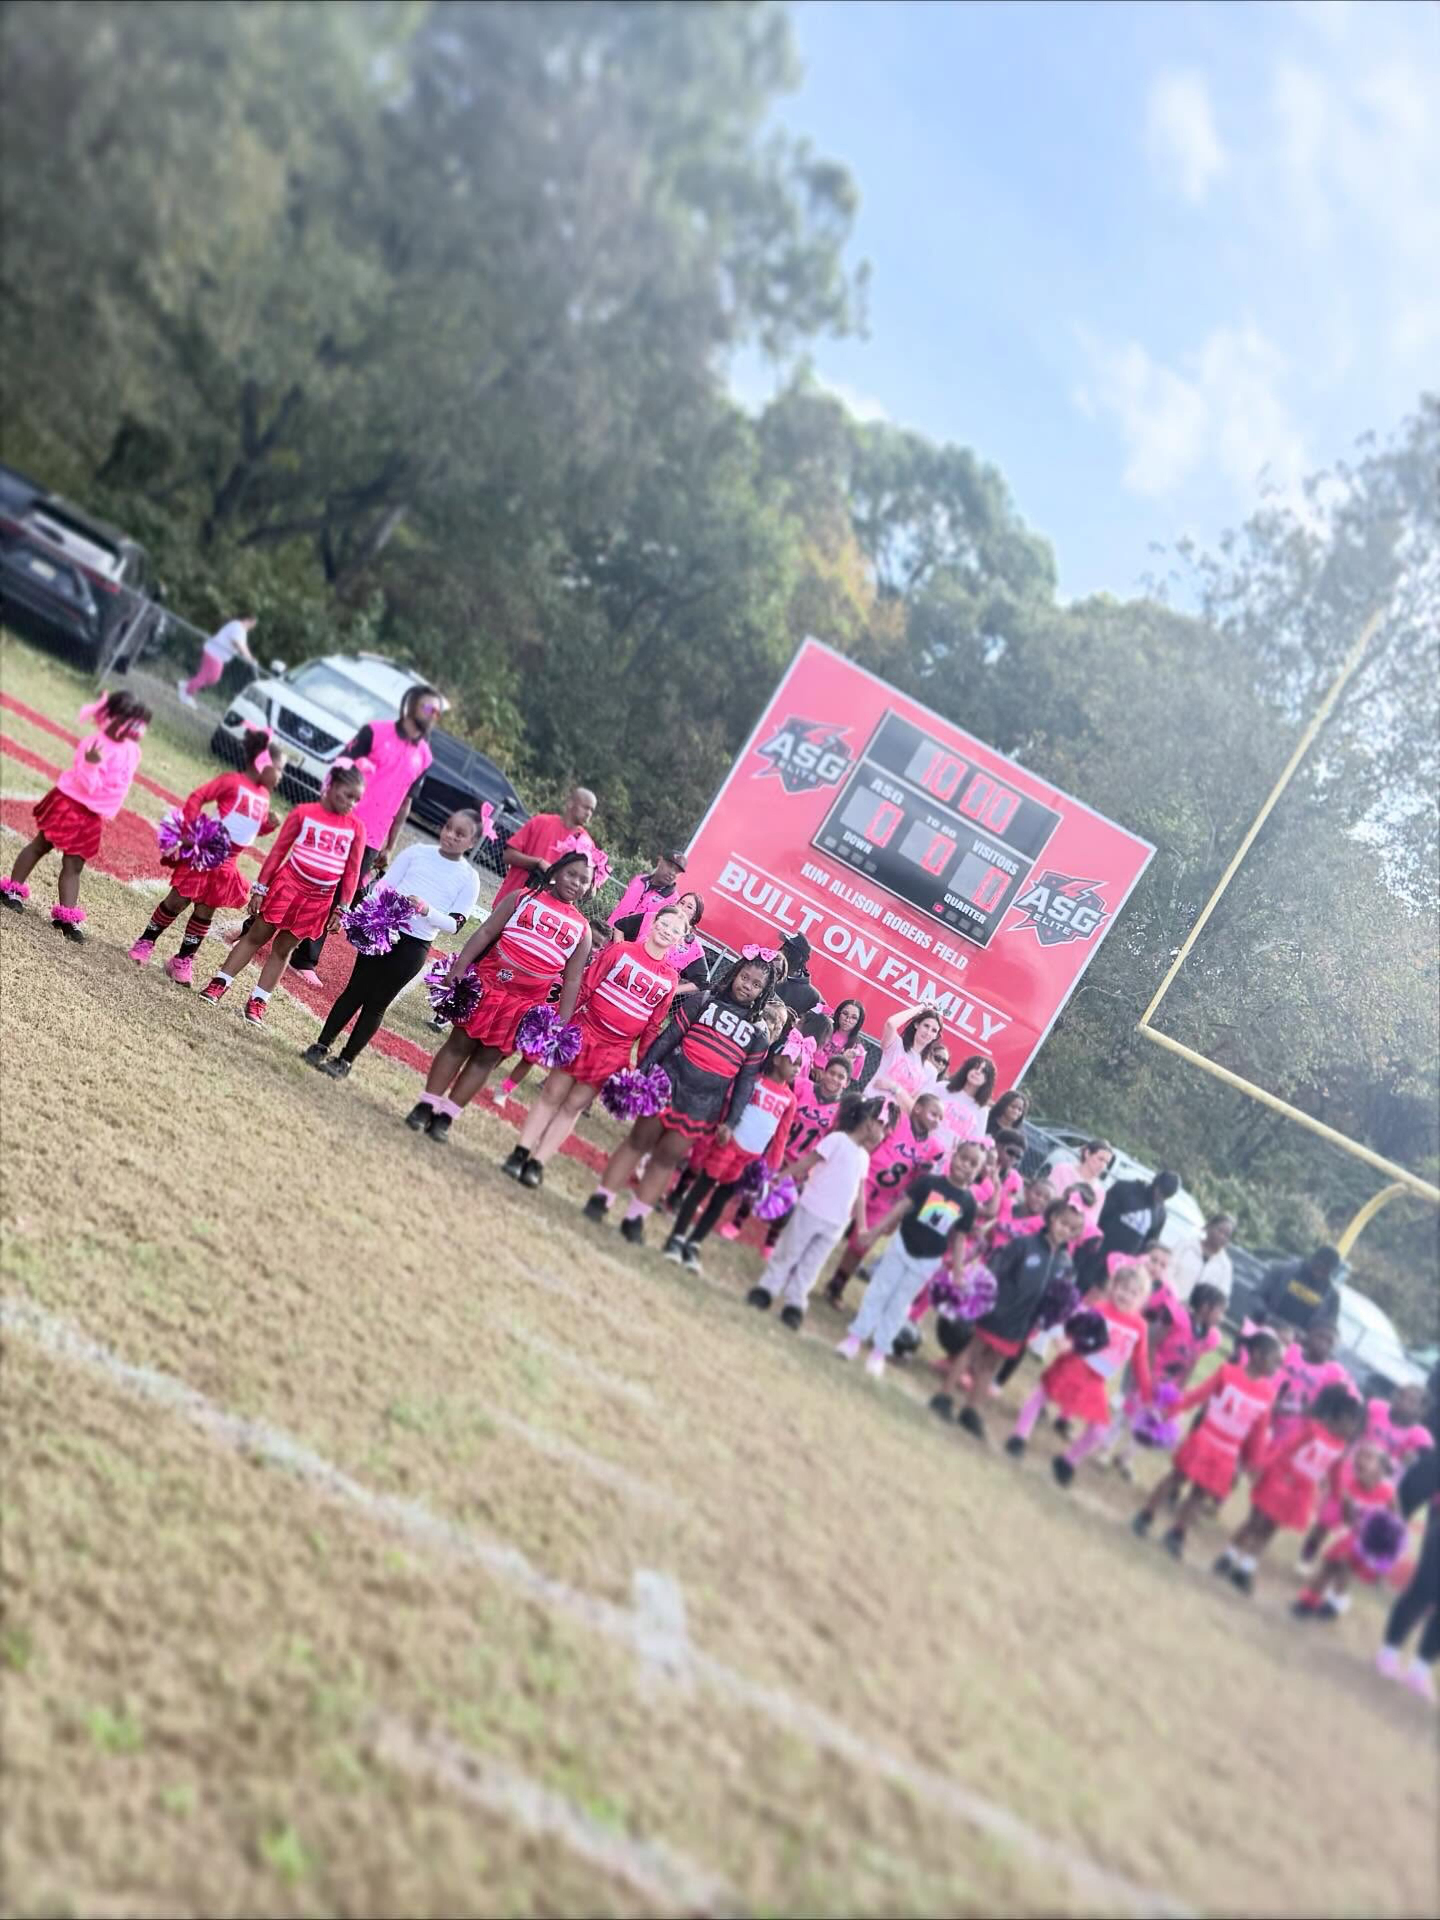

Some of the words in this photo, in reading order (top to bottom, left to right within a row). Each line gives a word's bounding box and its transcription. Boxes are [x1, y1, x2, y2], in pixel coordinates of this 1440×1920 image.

[762, 732, 848, 781] ASG
[870, 778, 905, 805] ASG
[303, 826, 350, 857] ASG
[842, 831, 873, 854] DOWN
[863, 800, 905, 849] 0
[920, 831, 957, 877] 0
[972, 839, 1020, 876] VISITORS
[943, 893, 987, 925] QUARTER
[970, 865, 1013, 913] 0
[1016, 885, 1102, 934] ASG
[516, 903, 579, 949] ASG
[800, 862, 830, 887] KIM
[829, 879, 884, 919] ALLISON
[882, 911, 933, 949] ROGERS
[931, 941, 969, 971] FIELD
[1032, 913, 1073, 936] ELITE
[717, 860, 825, 935] BUILT
[823, 925, 878, 971] ON
[876, 955, 1007, 1042] FAMILY
[613, 962, 670, 1006] ASG
[698, 1002, 756, 1048] ASG
[750, 1087, 786, 1118] ASG
[876, 1162, 909, 1188] 8
